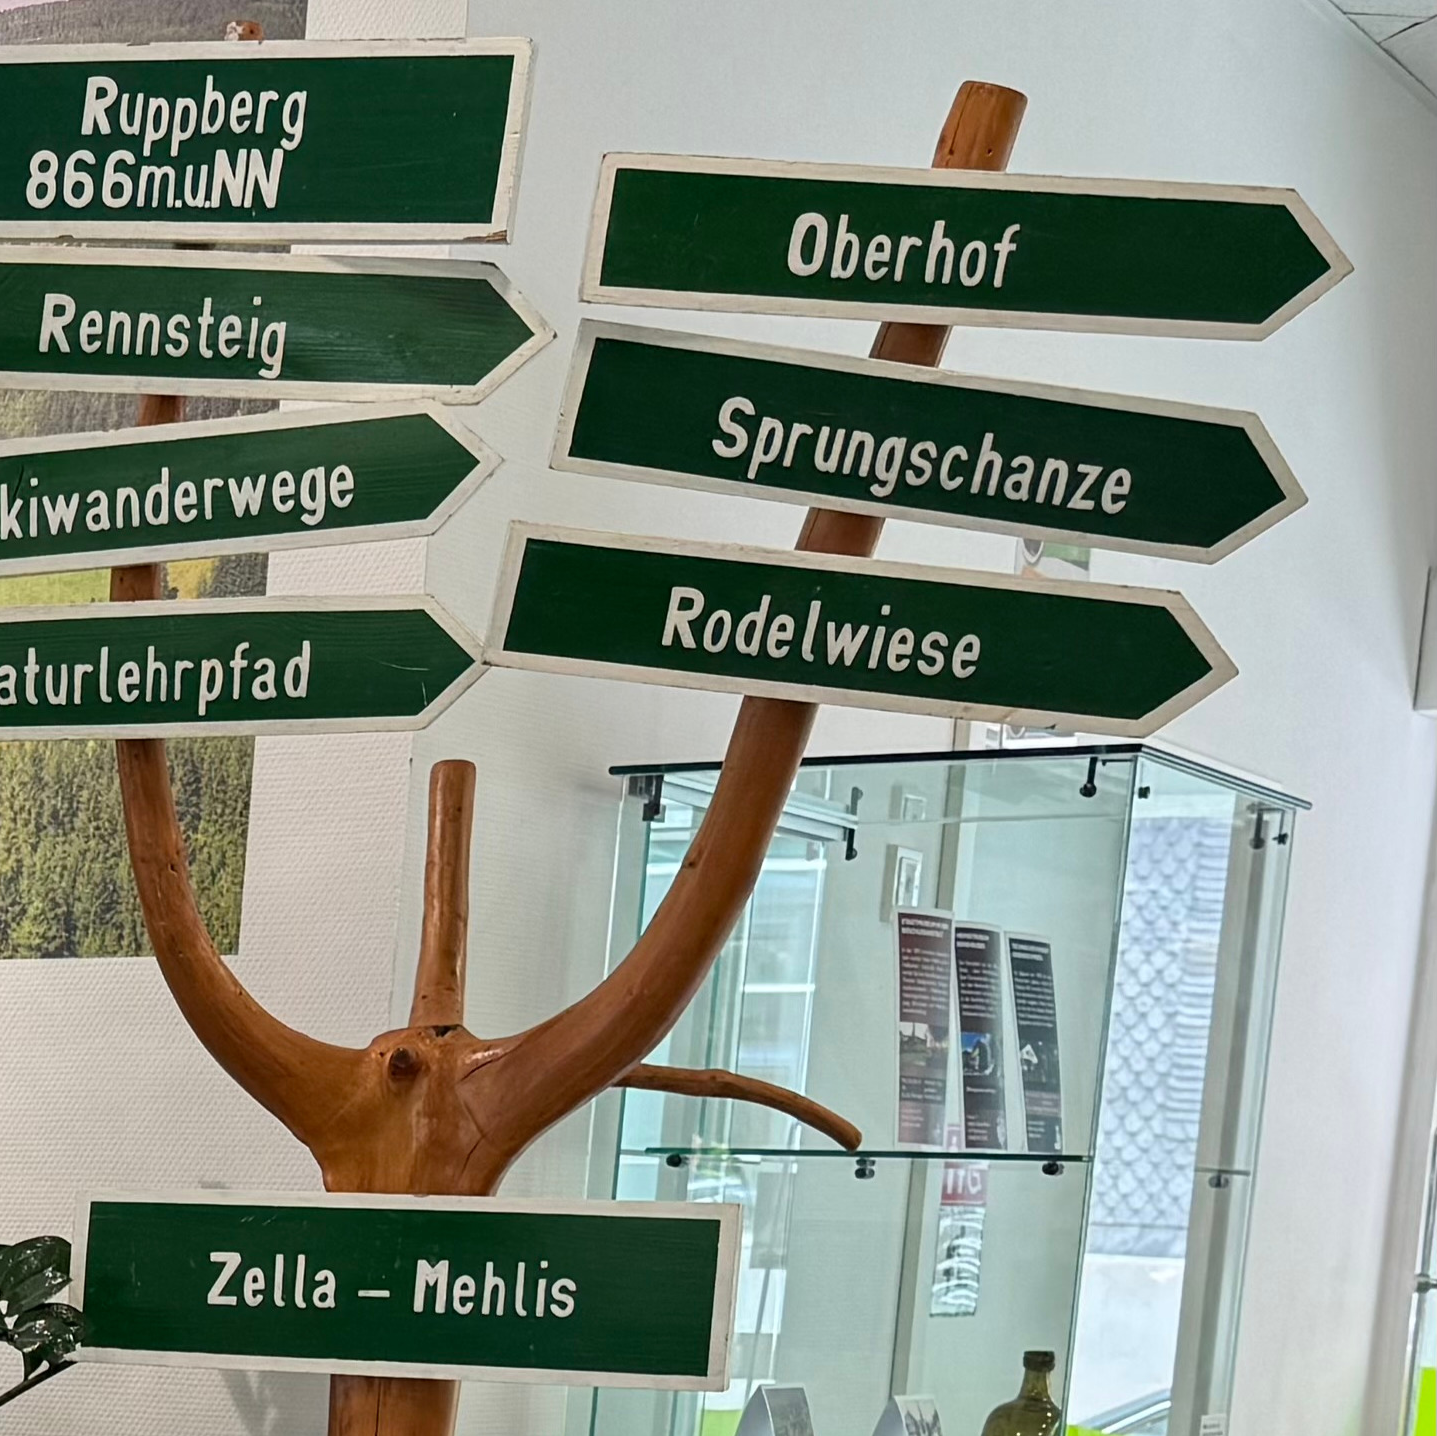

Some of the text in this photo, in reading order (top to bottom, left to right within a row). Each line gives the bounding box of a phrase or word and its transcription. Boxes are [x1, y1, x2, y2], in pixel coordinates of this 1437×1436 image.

[81, 75, 307, 156] Ruppberg
[787, 213, 1020, 288] Oberhof
[39, 294, 287, 379] Rennsteig
[712, 396, 1131, 514] Sprungschanze
[661, 586, 981, 678] Rodelwiese
[208, 1252, 336, 1309] Zella
[413, 1260, 577, 1318] Mehlis
